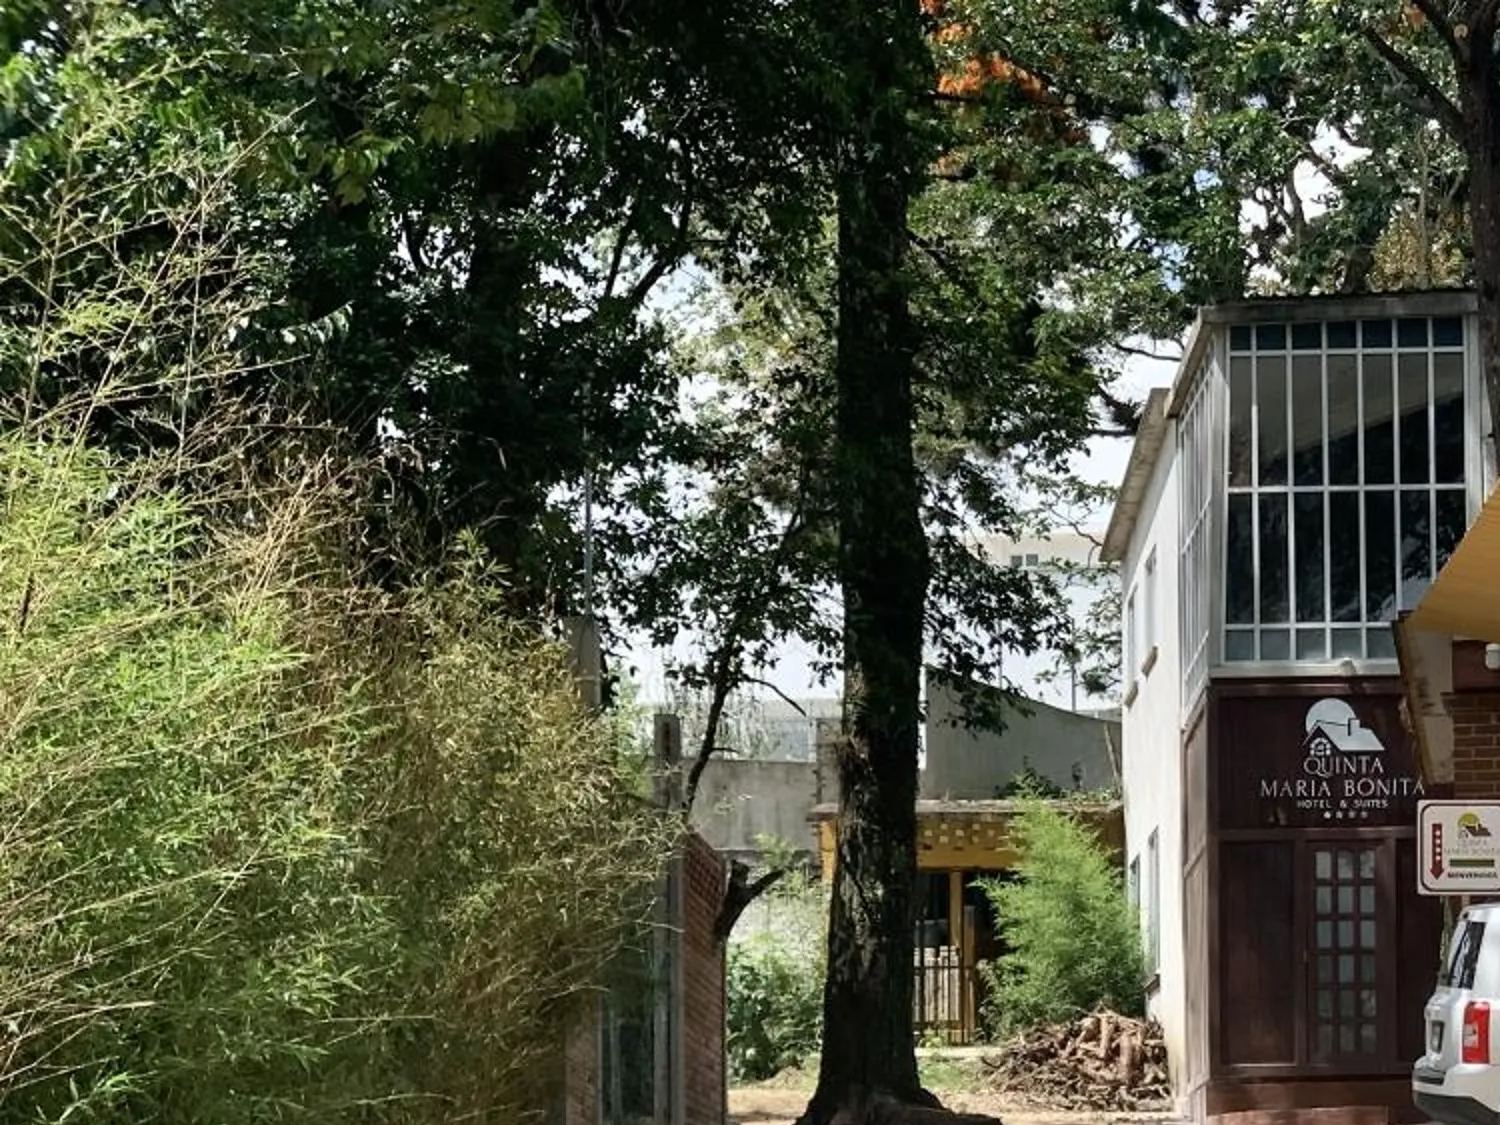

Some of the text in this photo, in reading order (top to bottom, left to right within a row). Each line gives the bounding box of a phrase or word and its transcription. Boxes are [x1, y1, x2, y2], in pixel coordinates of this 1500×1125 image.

[1303, 756, 1384, 777] QUINTA
[1261, 776, 1425, 797] MARIA BONITA
[1297, 799, 1332, 809] HOTEL
